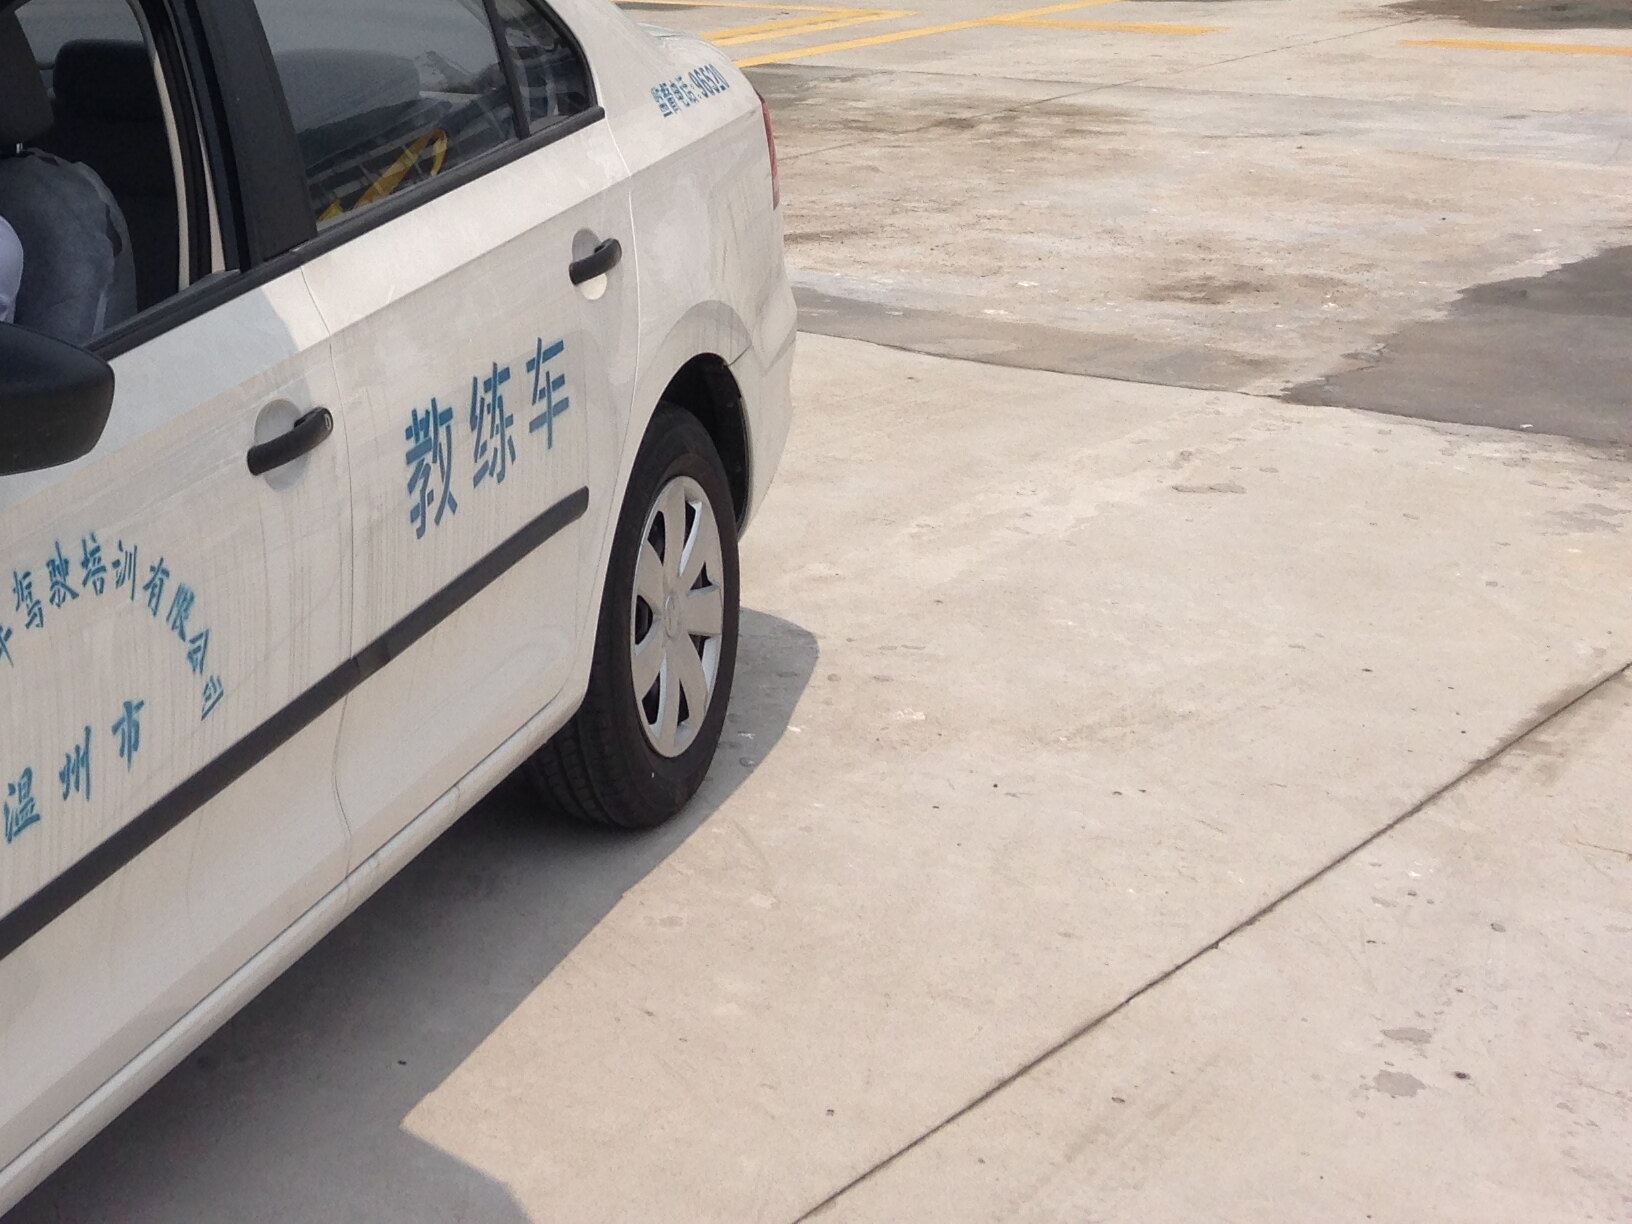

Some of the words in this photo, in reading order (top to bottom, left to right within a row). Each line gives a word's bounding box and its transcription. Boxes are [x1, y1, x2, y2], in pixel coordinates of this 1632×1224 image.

[404, 336, 570, 540] 教练车
[2, 698, 146, 844] 温州市
